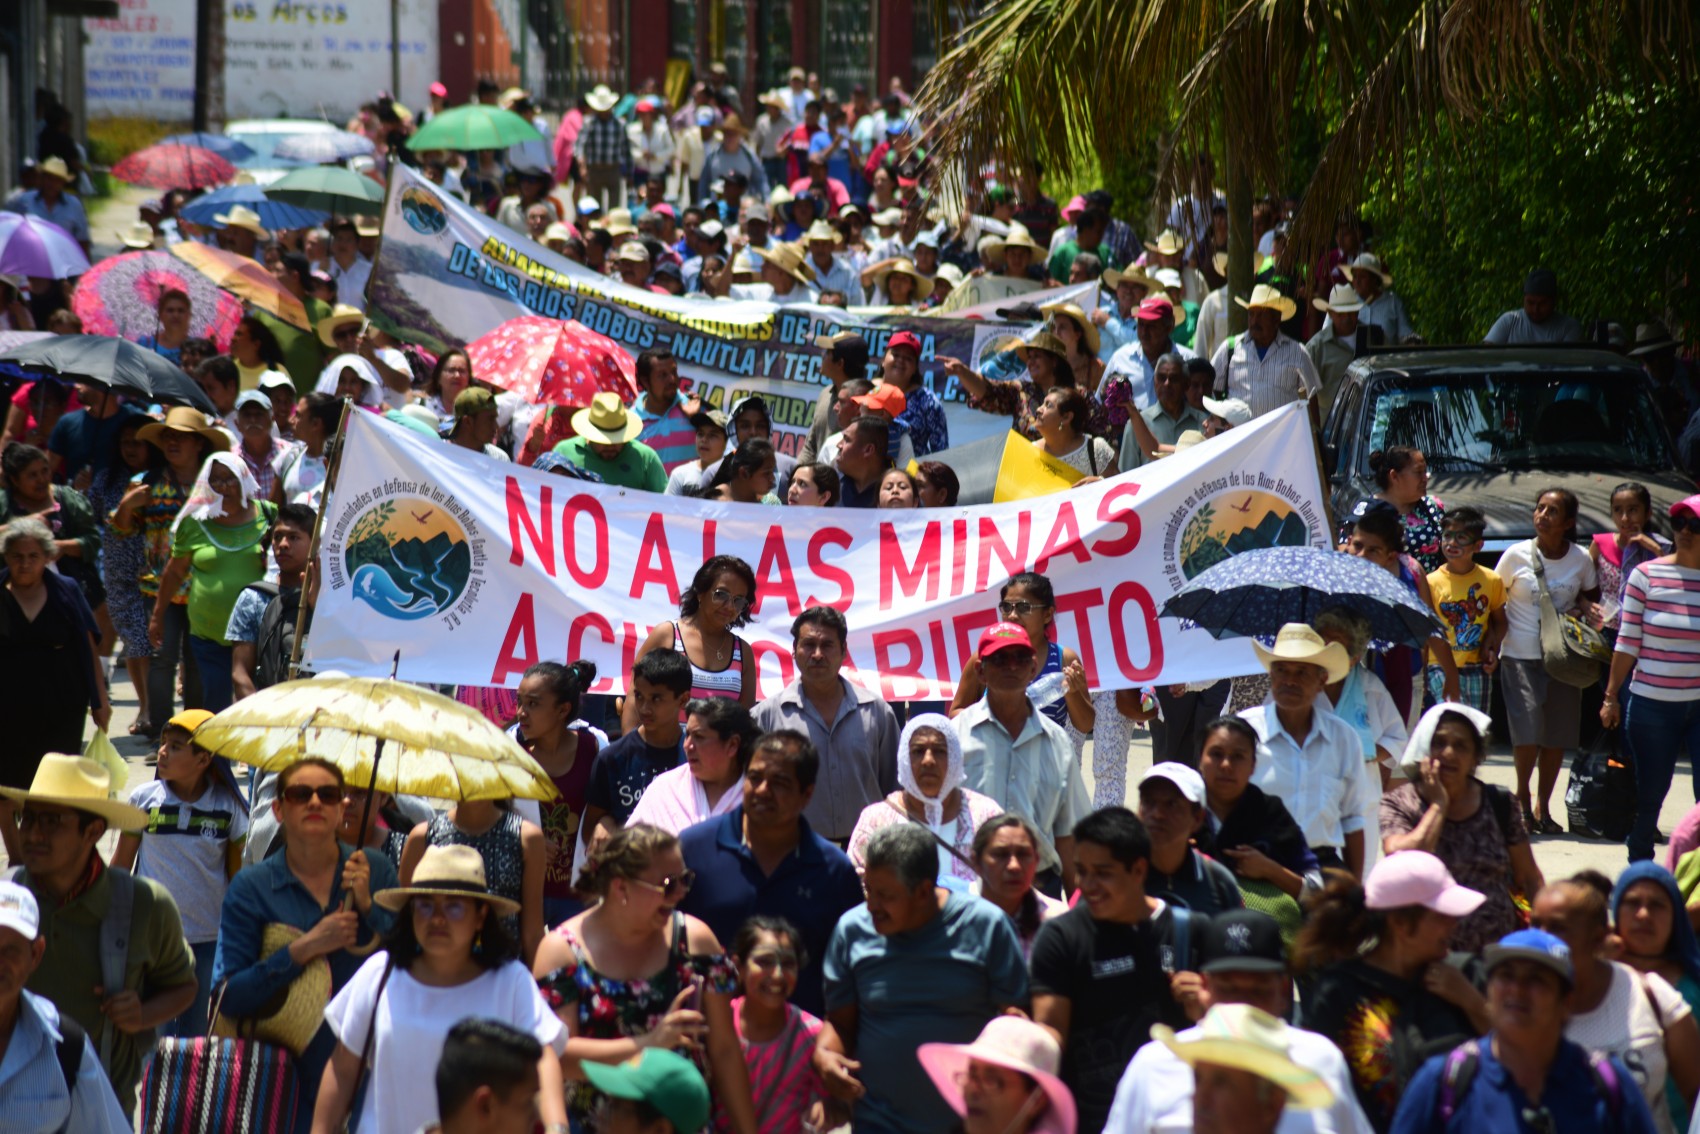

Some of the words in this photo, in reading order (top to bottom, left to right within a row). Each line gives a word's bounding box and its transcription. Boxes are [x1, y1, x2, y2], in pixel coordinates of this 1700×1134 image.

[231, 1, 257, 22] os
[481, 235, 571, 292] ALIANZA
[780, 314, 810, 345] DE
[449, 242, 484, 280] DE
[484, 259, 521, 300] LOS
[523, 280, 577, 321] RÍOS
[762, 349, 779, 377] Y
[384, 477, 417, 496] defensa
[1229, 471, 1240, 487] de
[1242, 469, 1255, 486] los
[372, 486, 383, 499] en
[419, 481, 430, 497] de
[431, 486, 445, 503] los
[1194, 477, 1228, 501] defensa
[1184, 496, 1197, 509] en
[332, 492, 373, 542] comunidades
[1299, 500, 1321, 534] Nautla
[505, 475, 609, 590] NO
[629, 512, 682, 605] A
[879, 482, 1142, 612] MINAS
[1163, 505, 1189, 561] comunidades
[326, 543, 341, 554] de
[329, 557, 345, 591] Alianza
[1162, 564, 1177, 575] de
[490, 592, 540, 686] A
[566, 611, 798, 701] CIO
[839, 581, 1165, 702] BIETO
